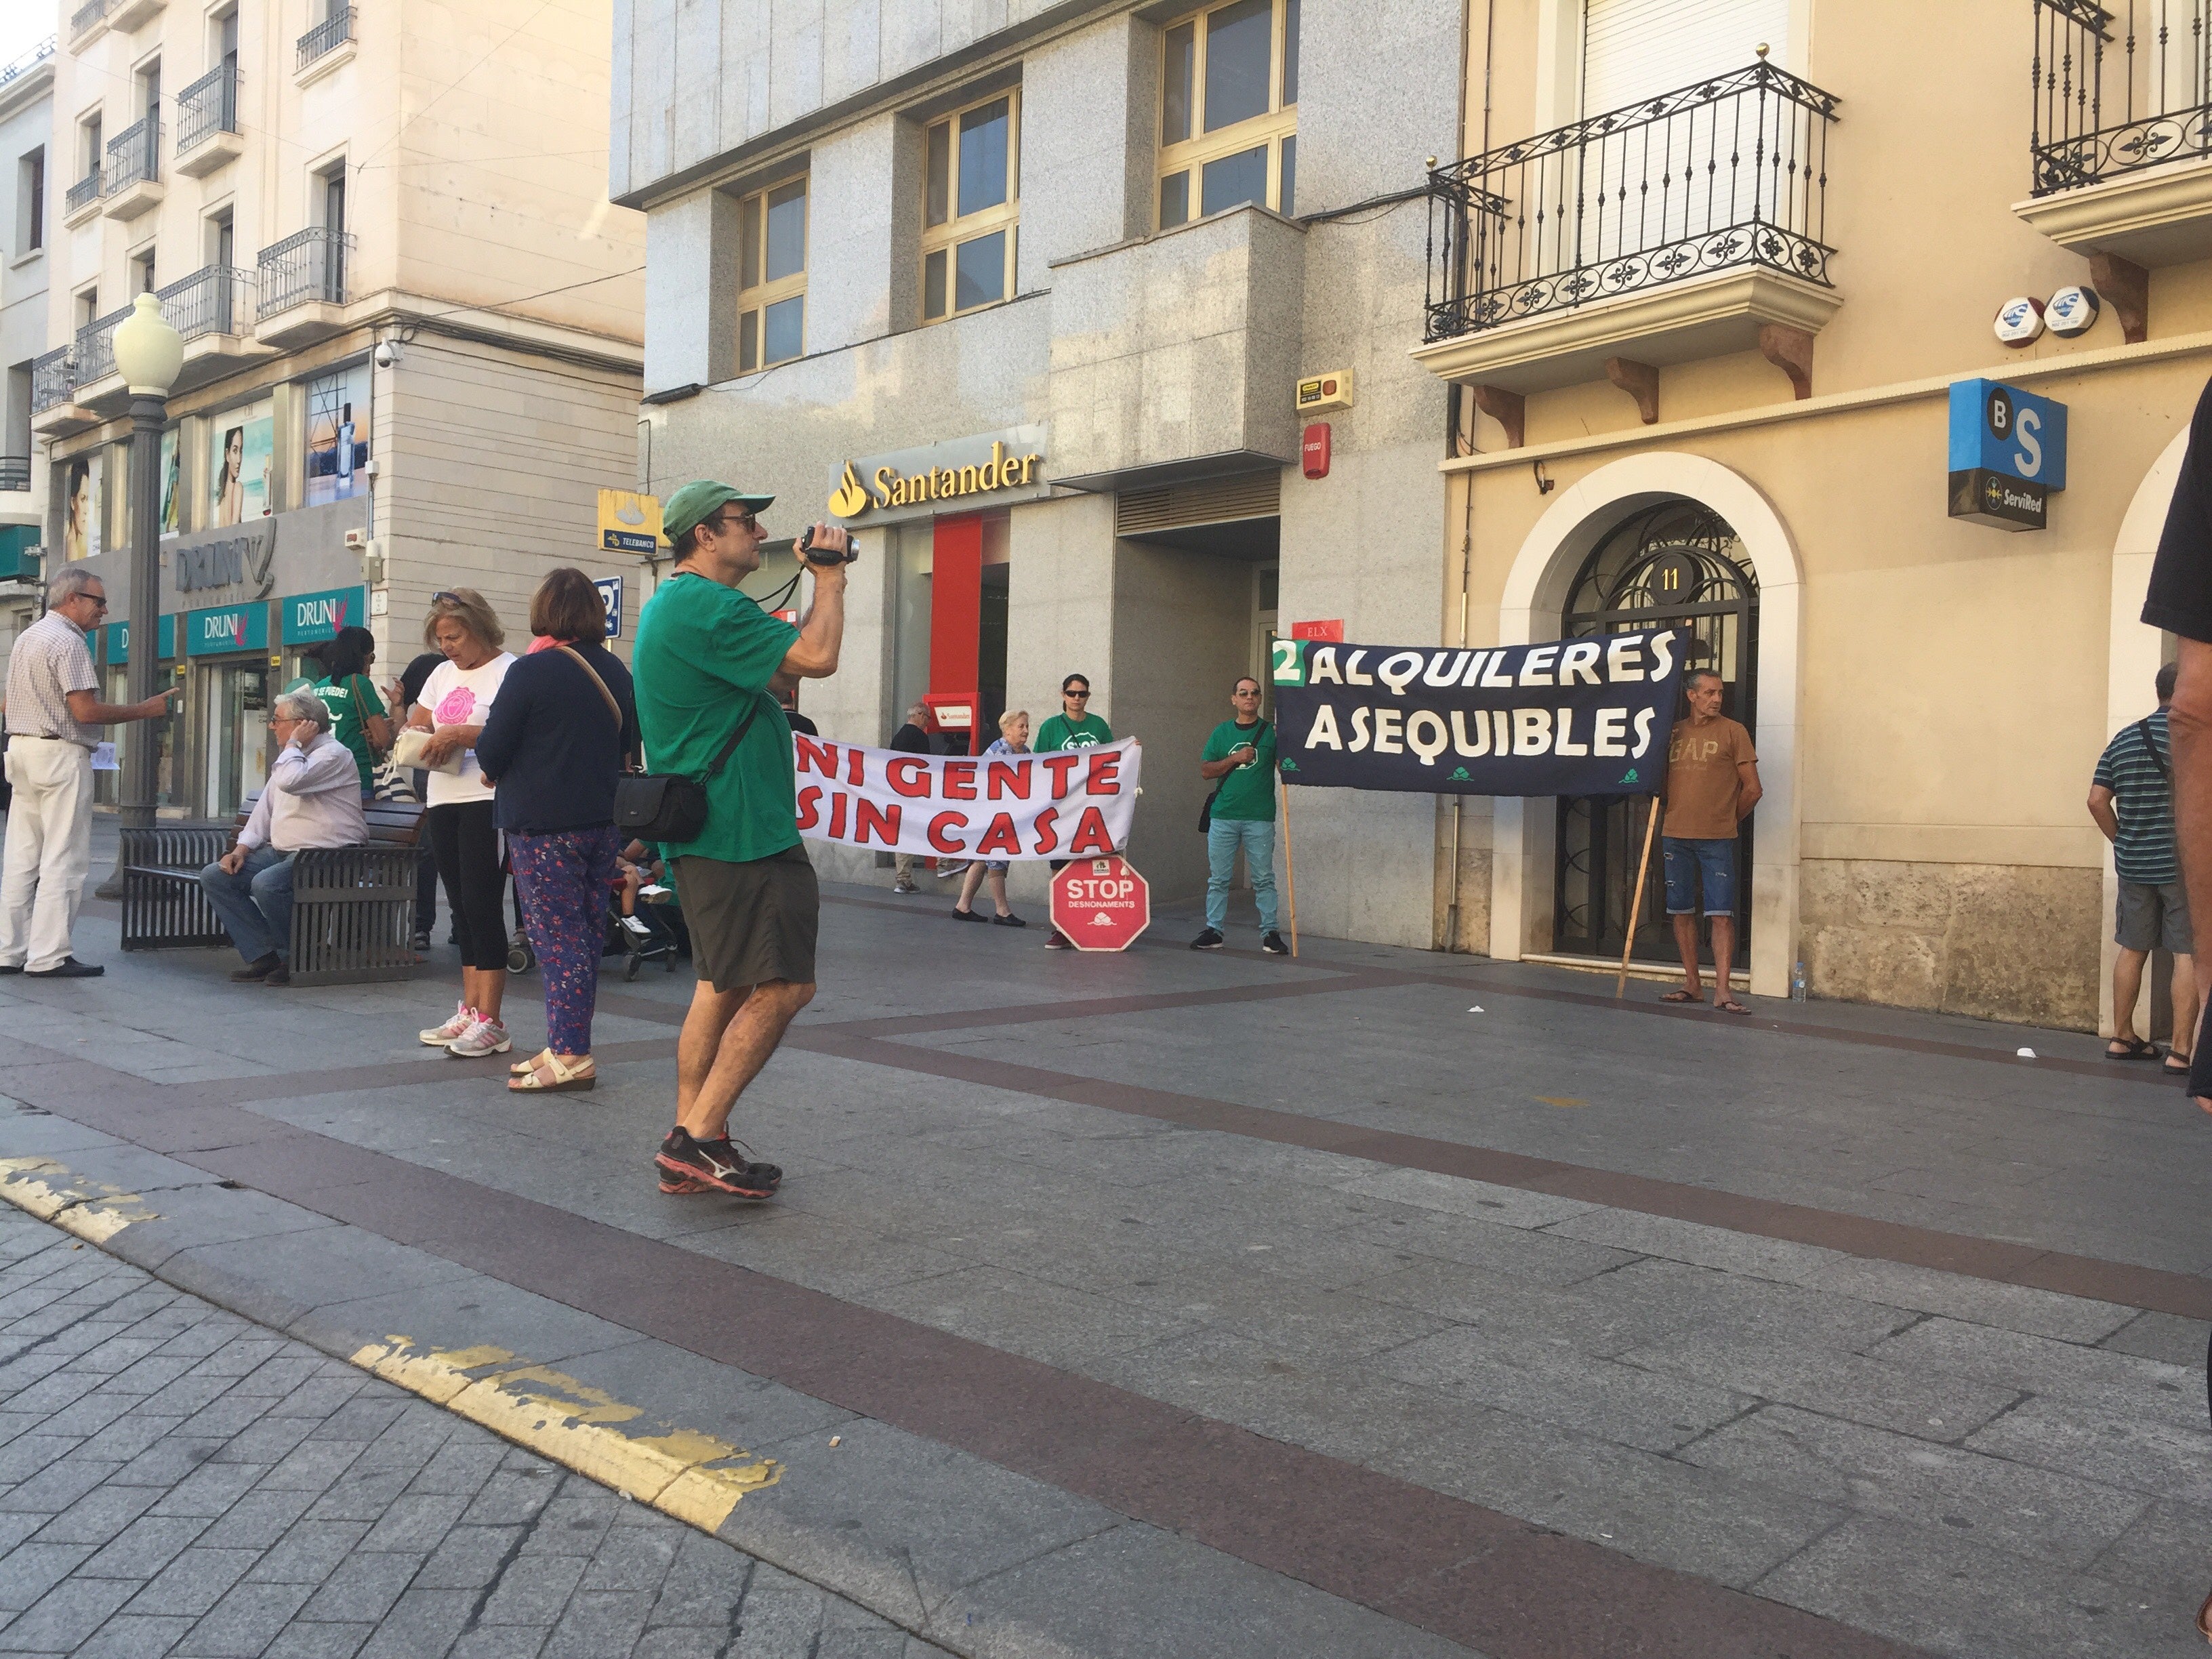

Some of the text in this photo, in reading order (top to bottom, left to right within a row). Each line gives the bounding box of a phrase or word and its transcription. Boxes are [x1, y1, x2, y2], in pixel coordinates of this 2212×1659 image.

[1994, 400, 2006, 428] B
[1305, 443, 1321, 451] FUEGO
[2014, 408, 2041, 477] S
[873, 441, 1039, 508] Santander
[2003, 488, 2042, 513] ServiRed
[623, 537, 654, 548] TELEBANCO
[1662, 568, 1678, 590] 11
[205, 613, 238, 638] DRUNI
[297, 598, 336, 627] DRUNI
[1307, 626, 1328, 637] ELX
[1273, 630, 1676, 695] 2 ALQUILERES
[1305, 704, 1655, 766] ASEQUIBLES
[796, 735, 1122, 800] NI GENTE
[796, 785, 1114, 855] SIN CASA
[1067, 879, 1134, 899] STOP
[1068, 901, 1135, 909] DESNONAMENTS
